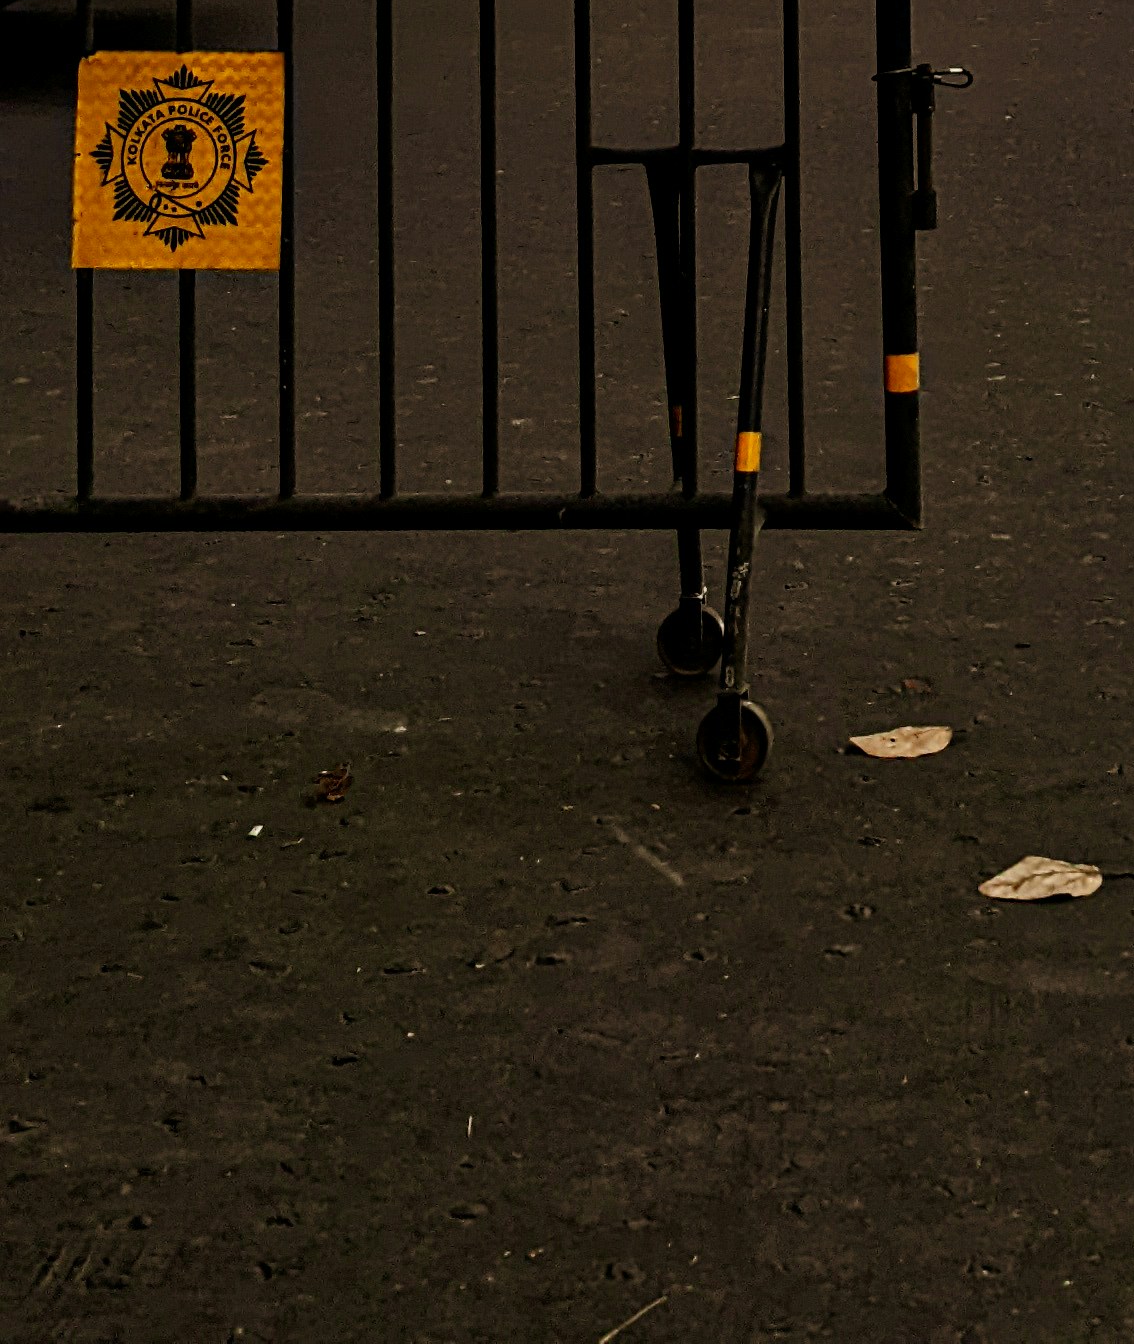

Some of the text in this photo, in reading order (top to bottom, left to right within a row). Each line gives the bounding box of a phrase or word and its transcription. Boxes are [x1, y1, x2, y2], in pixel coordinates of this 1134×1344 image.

[127, 104, 232, 170] KOLKATA POLICE FORCE
